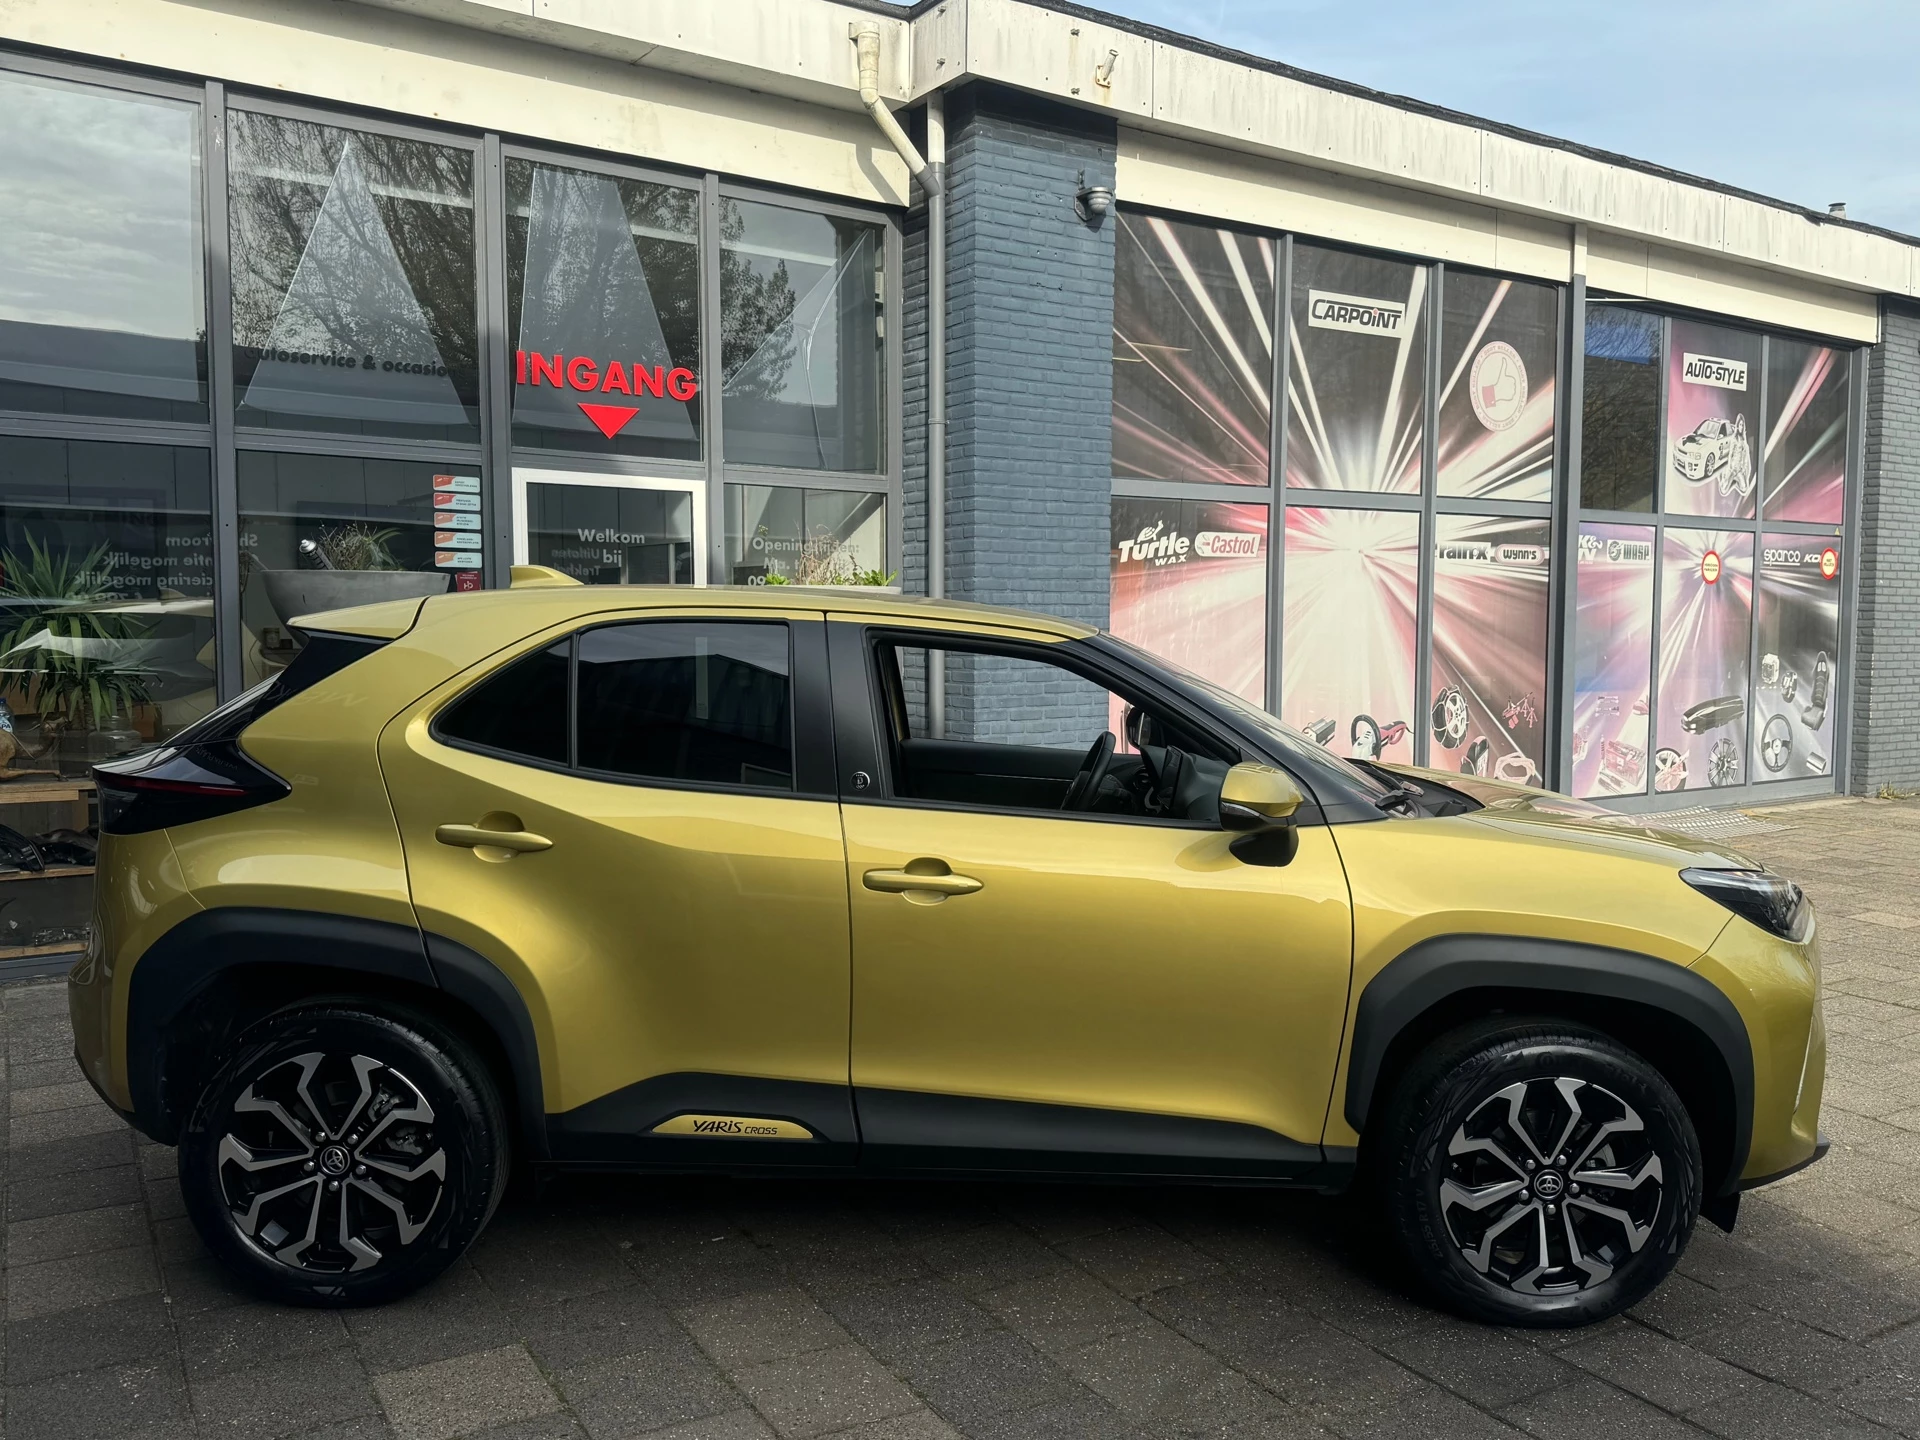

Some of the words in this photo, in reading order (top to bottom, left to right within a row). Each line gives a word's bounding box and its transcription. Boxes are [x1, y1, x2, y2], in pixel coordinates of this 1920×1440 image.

[362, 354, 377, 370] &
[516, 350, 697, 401] INGANG
[577, 528, 646, 544] Welkom
[1211, 534, 1255, 554] Castrol
[1118, 531, 1190, 563] Turtle
[1623, 544, 1650, 561] WASP
[602, 549, 622, 567] bij
[1154, 554, 1187, 567] WAX
[1763, 548, 1801, 566] sparco
[693, 1120, 743, 1133] YARIS
[744, 1126, 777, 1135] CROSS
